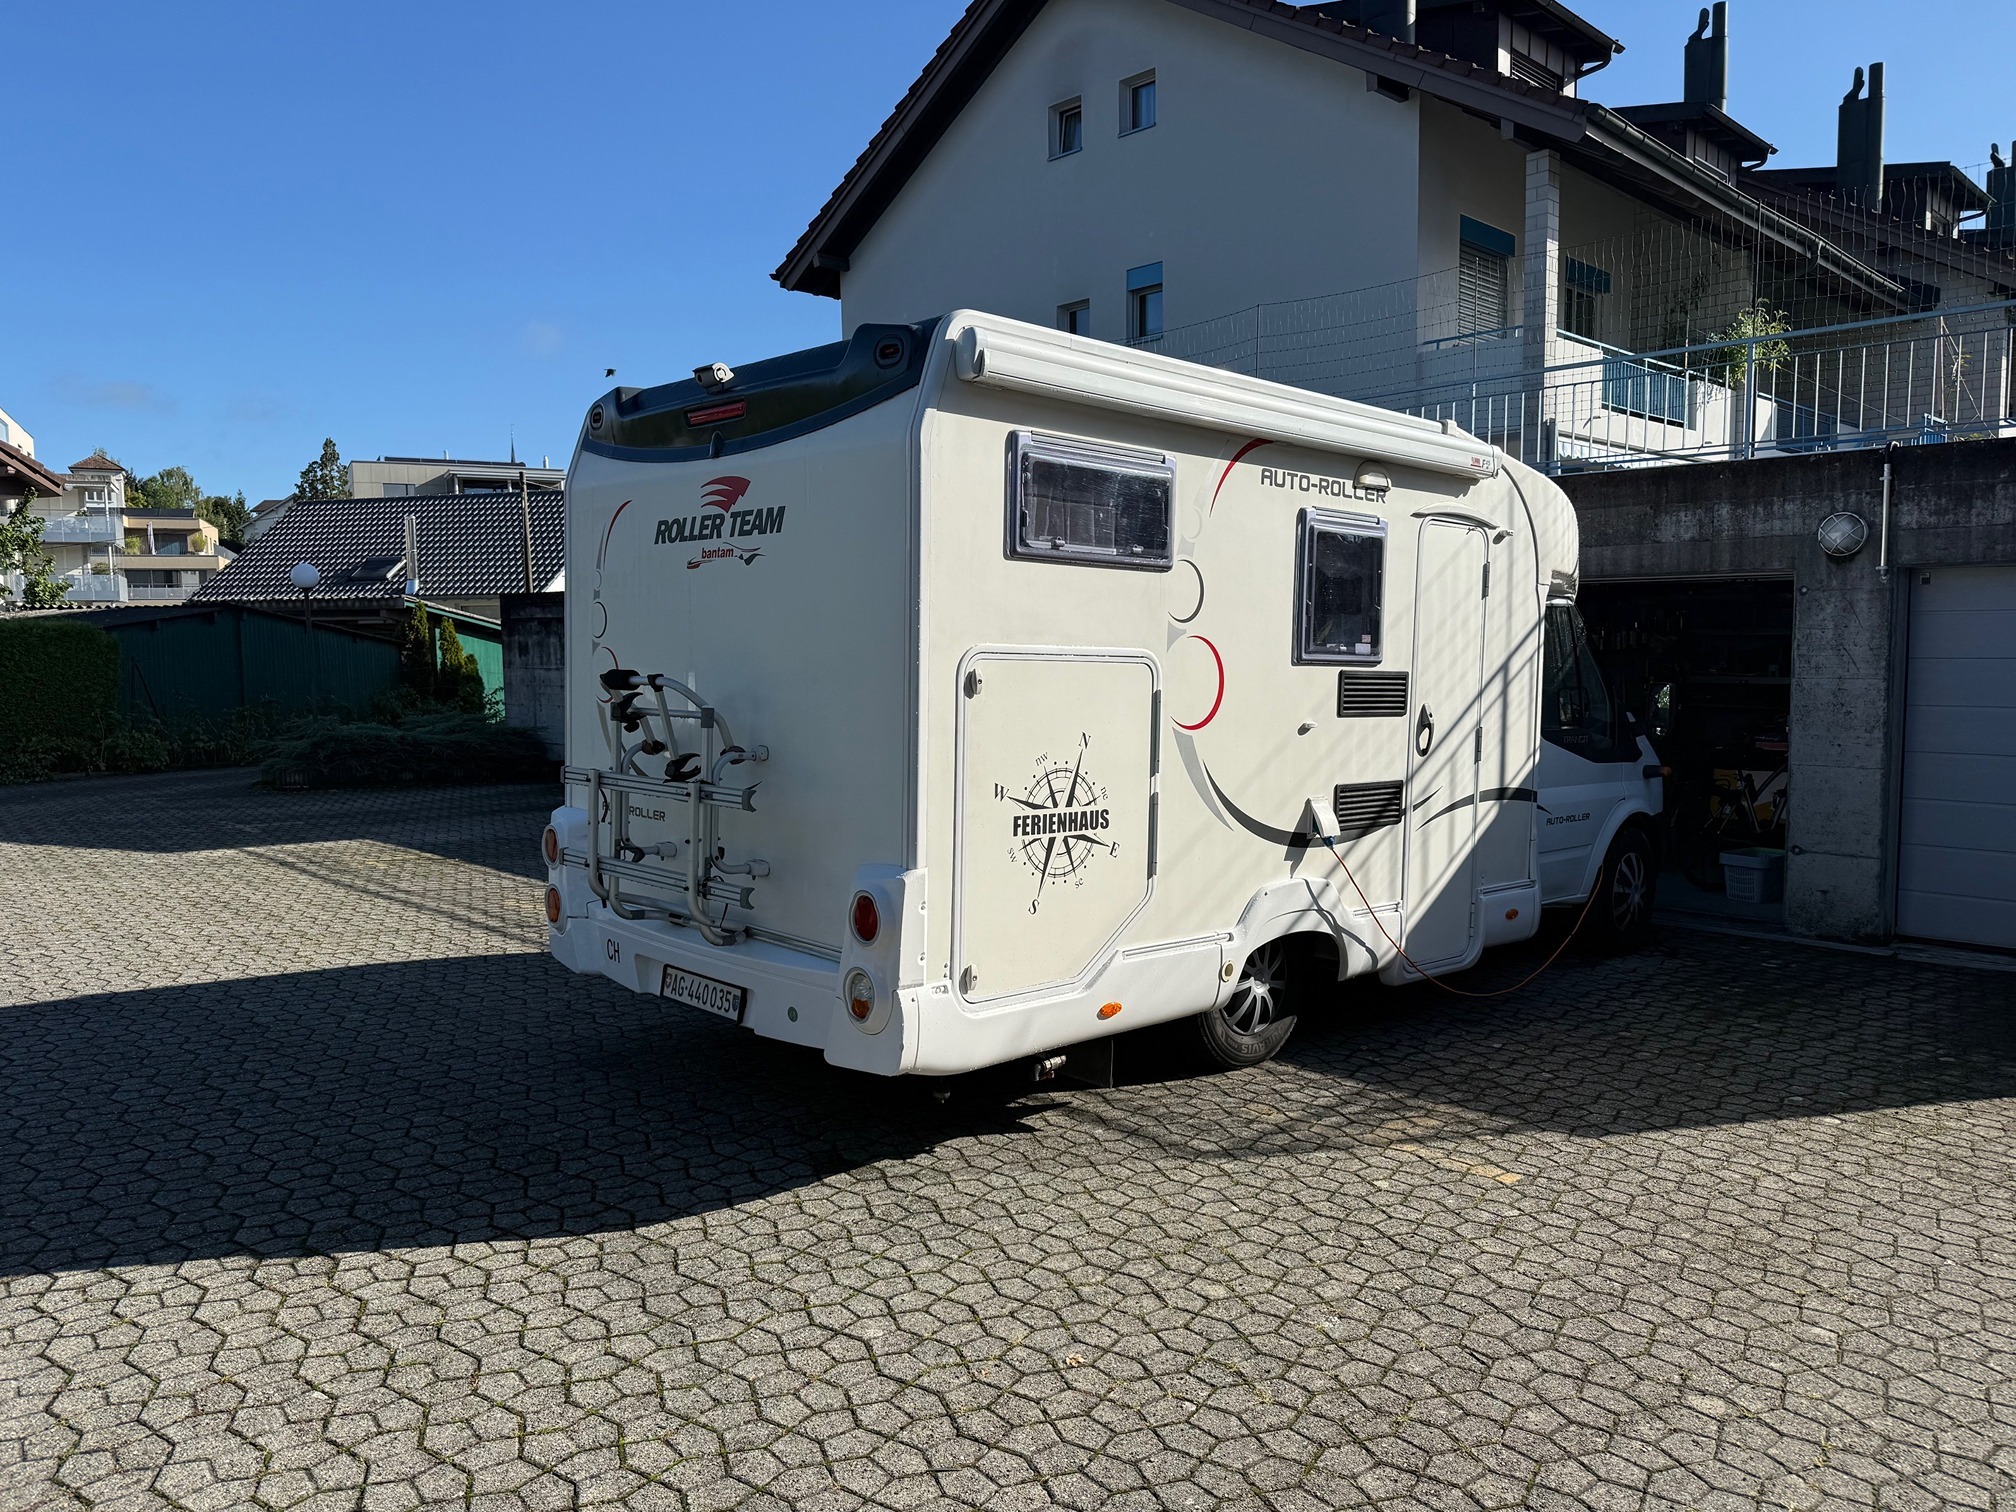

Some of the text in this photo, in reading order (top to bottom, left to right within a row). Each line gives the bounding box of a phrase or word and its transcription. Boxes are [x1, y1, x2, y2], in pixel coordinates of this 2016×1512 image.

[1261, 467, 1386, 504] AUTO-ROLLER
[654, 505, 786, 545] ROLLER TEAM
[701, 547, 734, 559] bantam
[1078, 732, 1091, 749] N
[994, 783, 1009, 802] W
[1013, 809, 1110, 837] FERIENHAUS
[1546, 813, 1590, 826] AUTO-ROLLER
[1109, 841, 1120, 858] E
[1028, 899, 1039, 915] S
[607, 938, 620, 963] CH
